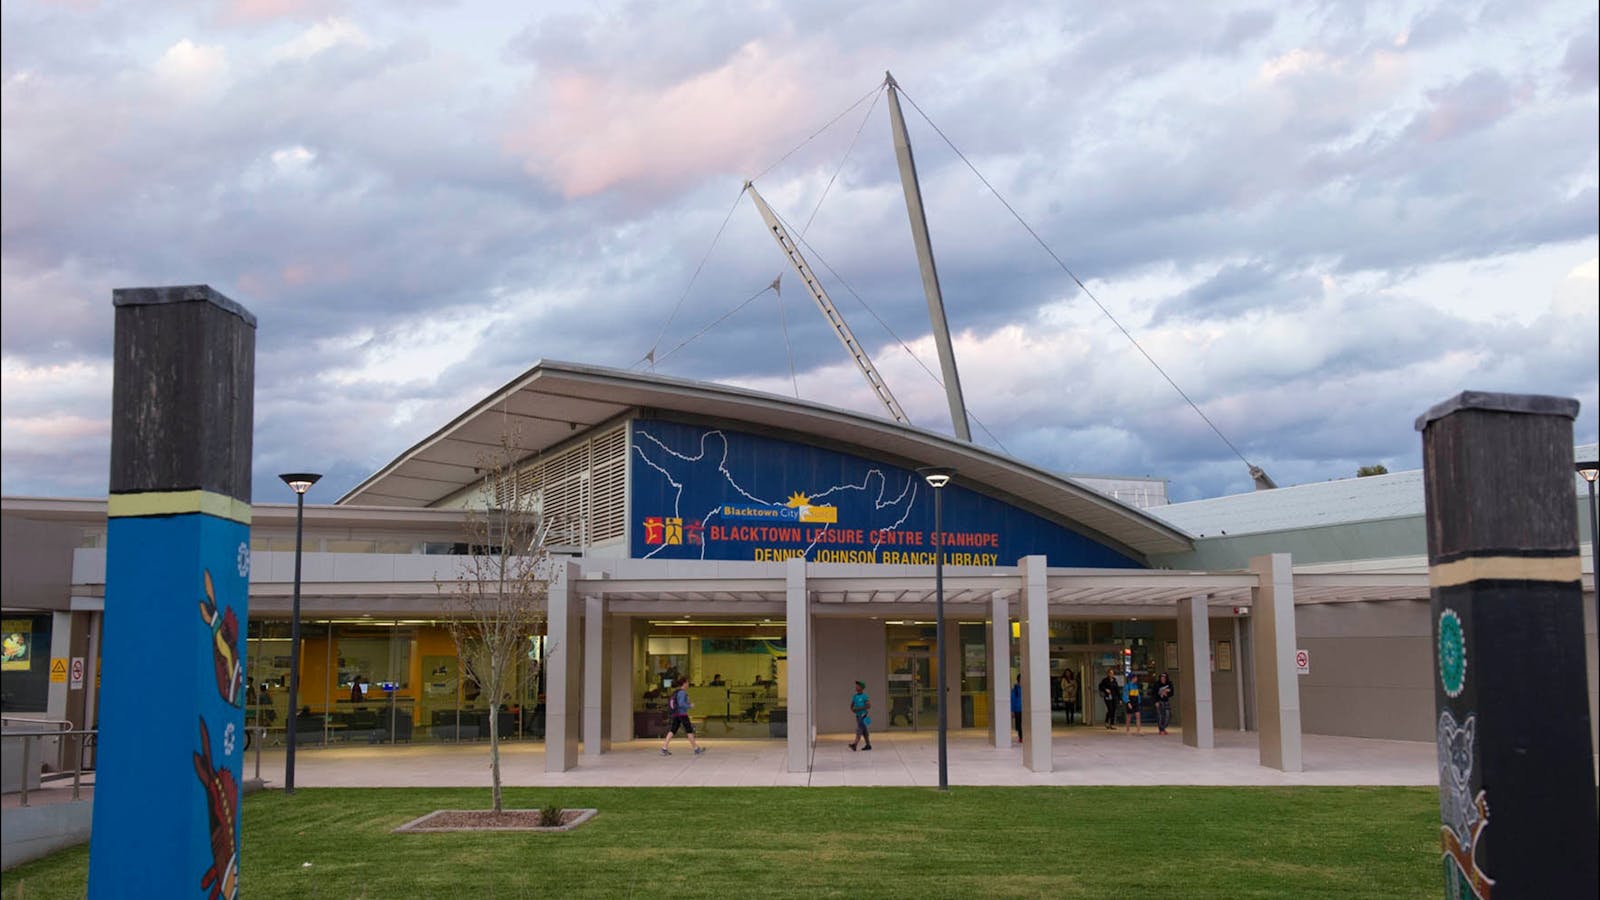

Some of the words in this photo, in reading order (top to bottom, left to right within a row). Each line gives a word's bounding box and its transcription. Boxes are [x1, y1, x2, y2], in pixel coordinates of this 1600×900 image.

[723, 506, 778, 517] Blacktown
[780, 508, 798, 520] City
[711, 526, 800, 542] BLACKTOWN
[806, 528, 863, 544] LEISURE
[869, 530, 923, 545] CENTRE
[931, 532, 999, 547] STANHOPE
[755, 548, 804, 562] DENNIS
[814, 550, 876, 564] JOHNSON
[883, 551, 937, 565] BRANCH
[944, 553, 998, 567] LIBRARY
